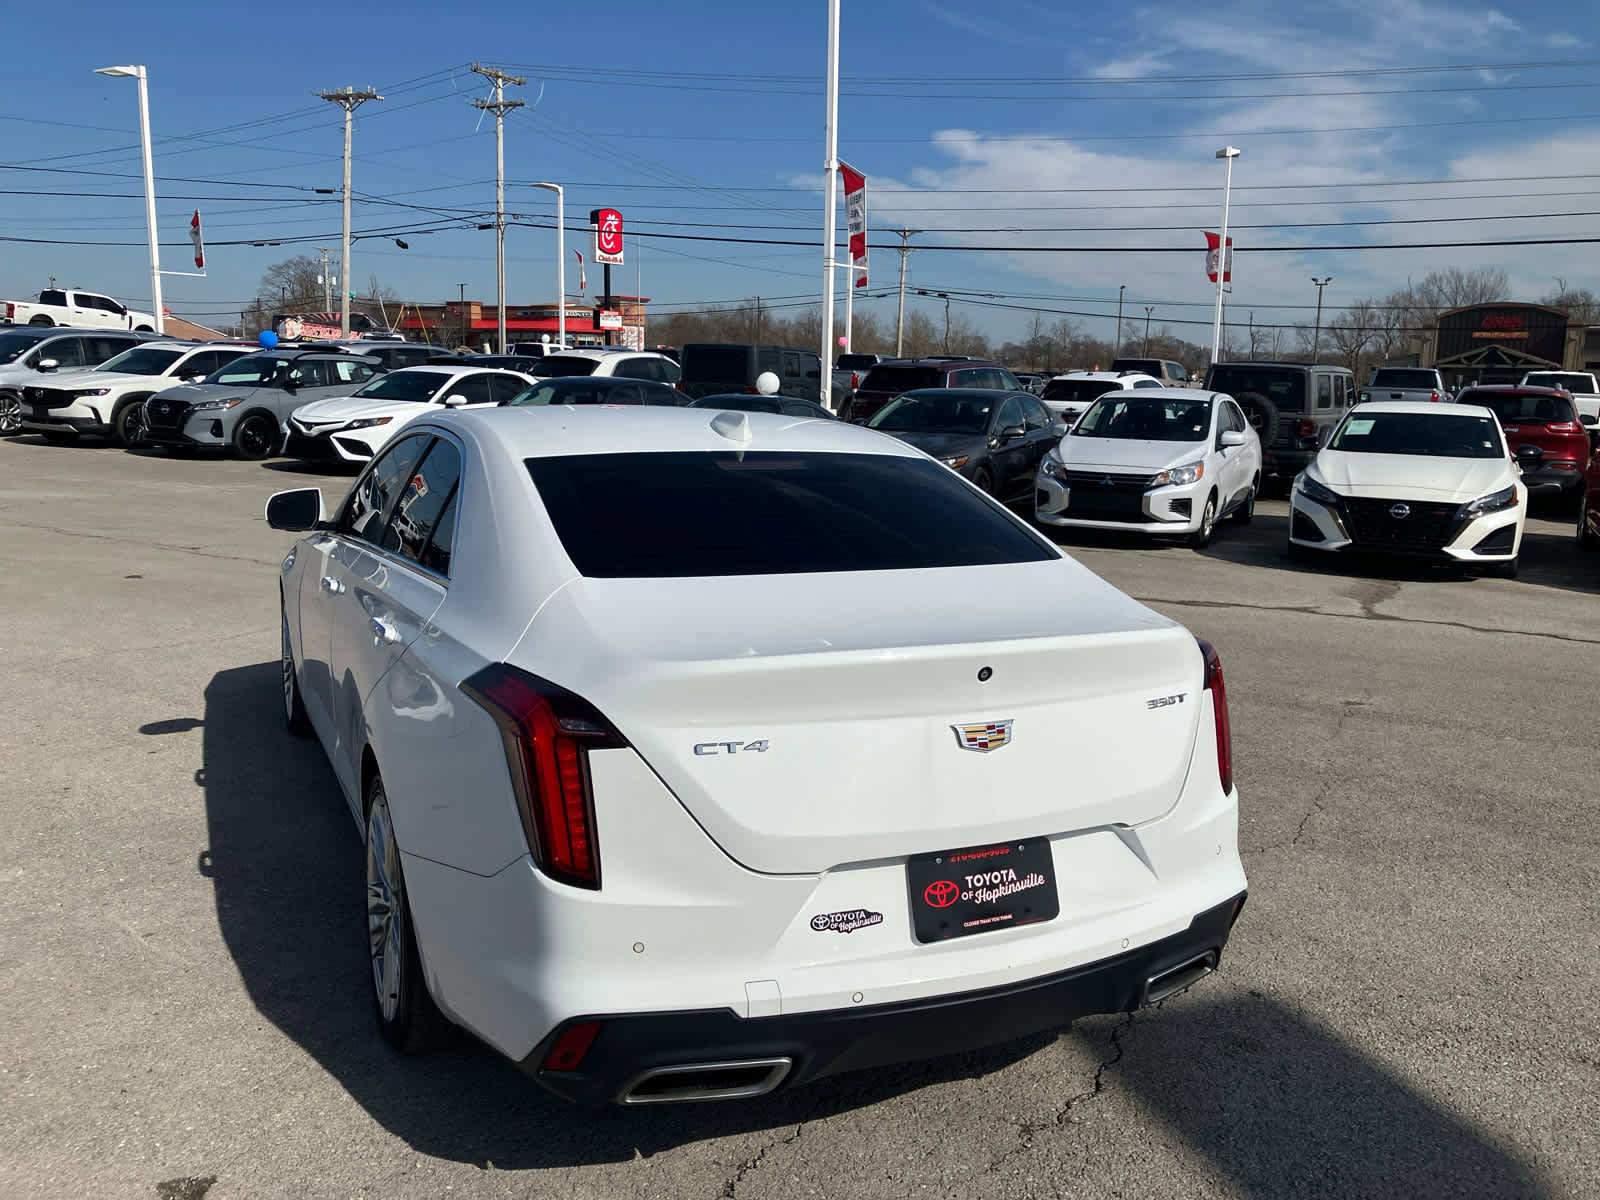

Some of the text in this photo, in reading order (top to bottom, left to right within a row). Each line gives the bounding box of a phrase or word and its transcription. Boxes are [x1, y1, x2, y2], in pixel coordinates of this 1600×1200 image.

[1145, 693, 1188, 710] 350T
[694, 739, 769, 756] CT4
[965, 868, 1017, 888] TOYOTA
[961, 873, 1045, 904] OF Hopkinsville
[830, 911, 866, 922] TOYOTA
[839, 914, 882, 931] Hopkinsville
